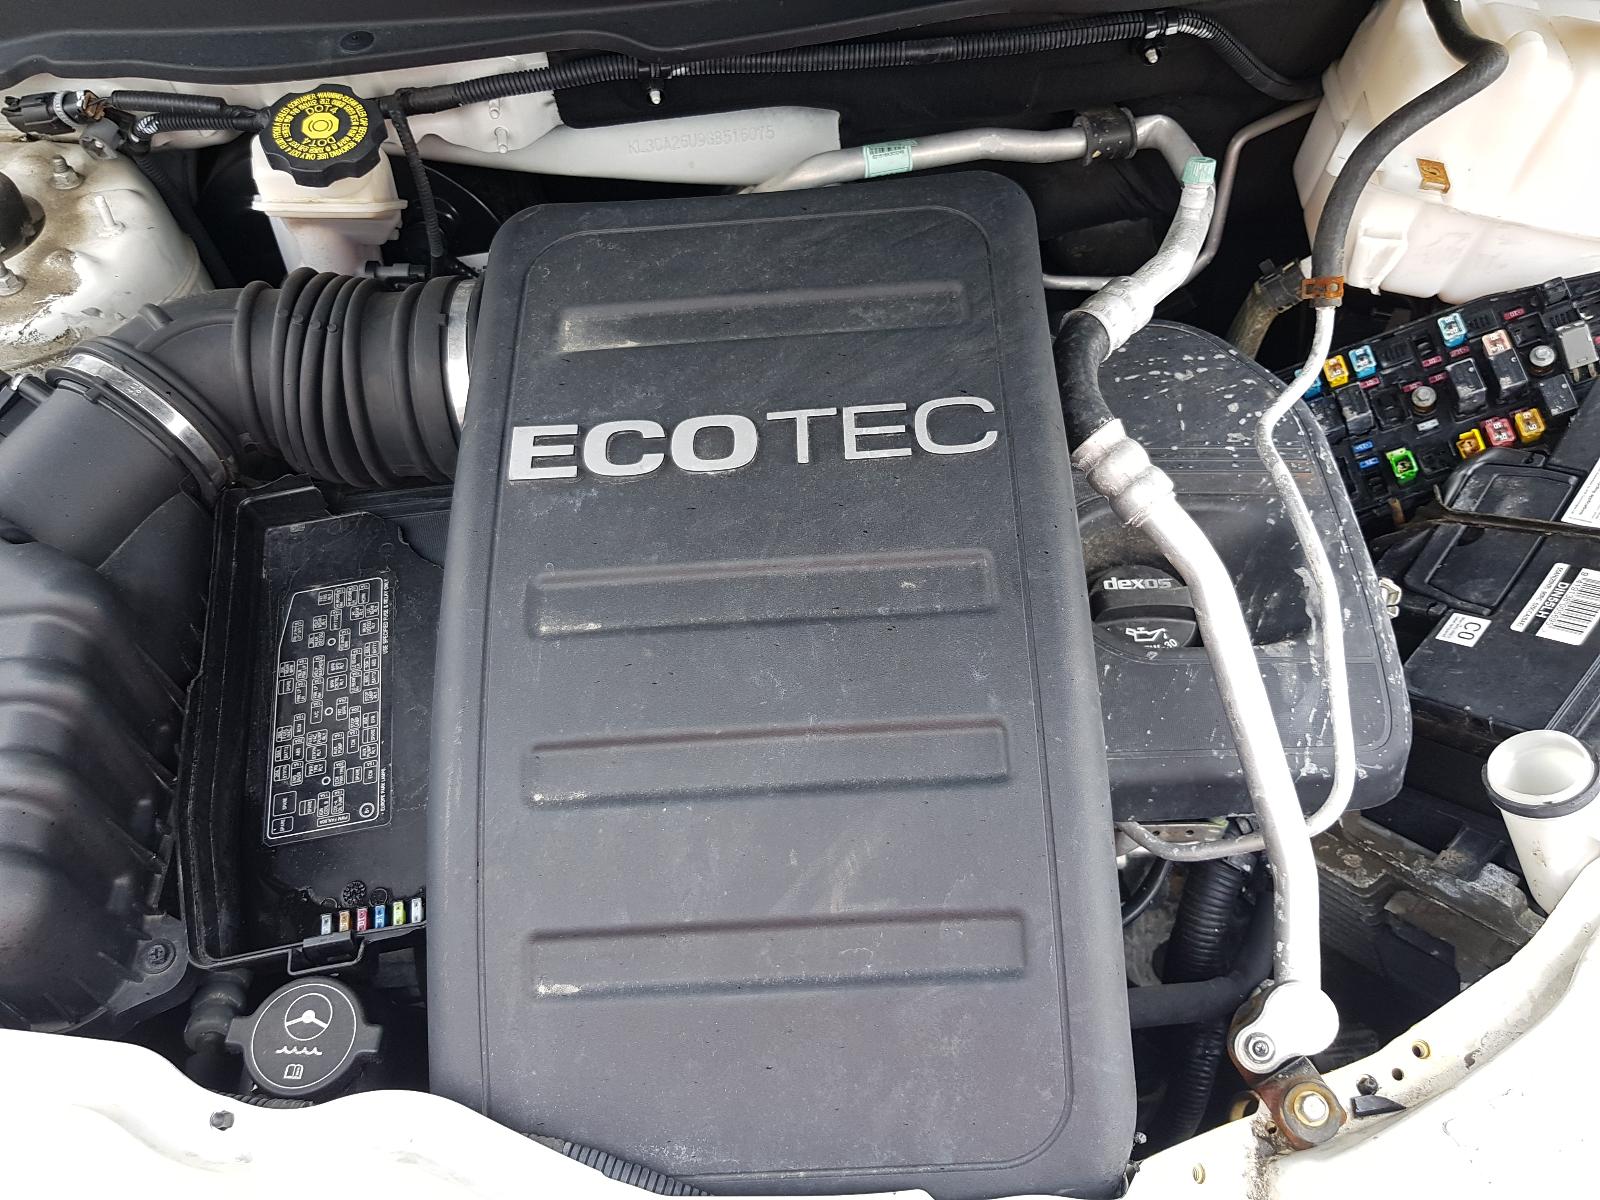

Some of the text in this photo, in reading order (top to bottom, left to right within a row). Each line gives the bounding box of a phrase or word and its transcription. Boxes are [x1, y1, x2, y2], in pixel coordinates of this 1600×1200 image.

[299, 152, 316, 160] ONLY
[508, 396, 999, 481] ECOTEC
[1103, 577, 1172, 590] dexos
